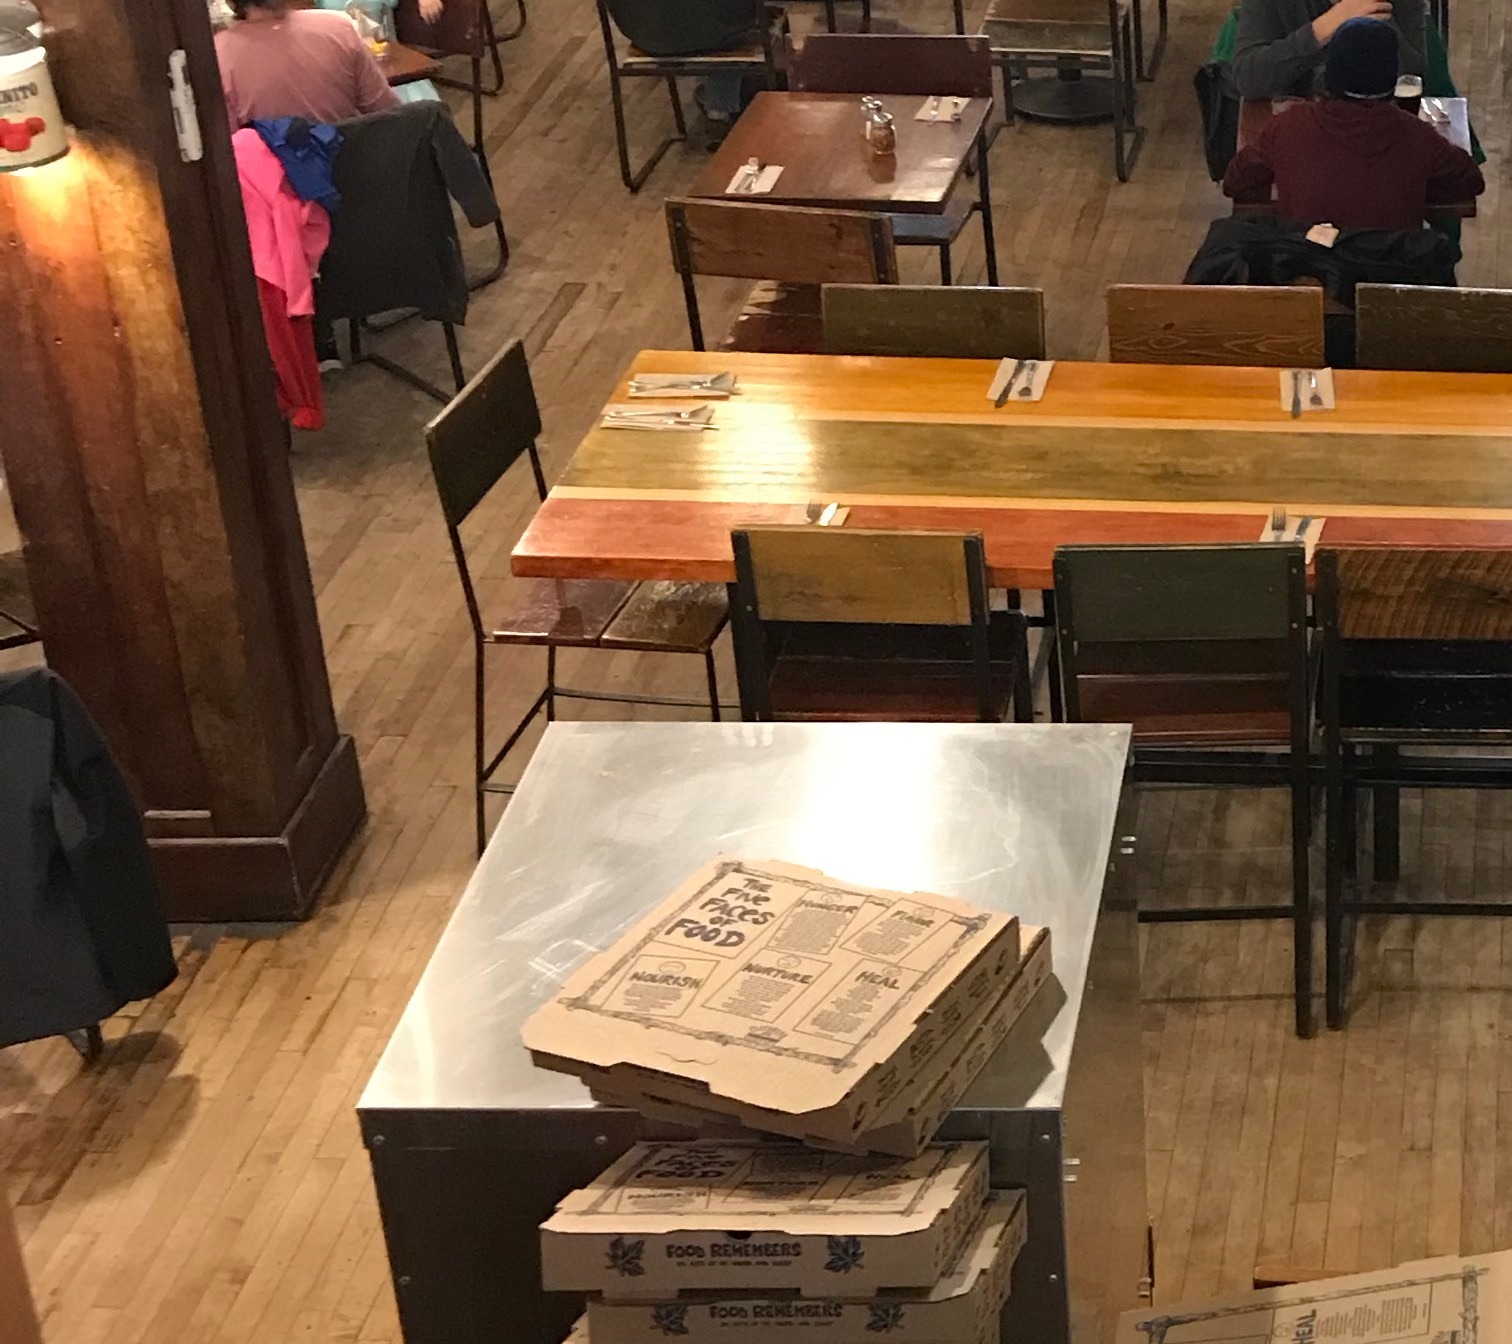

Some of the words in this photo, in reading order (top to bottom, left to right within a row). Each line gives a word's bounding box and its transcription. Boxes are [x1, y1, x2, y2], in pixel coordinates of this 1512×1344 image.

[743, 877, 773, 893] THE
[708, 915, 740, 928] OF
[664, 917, 745, 947] FOOD
[629, 971, 704, 991] NOURISH
[742, 962, 813, 985] NURTURE
[855, 970, 900, 990] HEAL
[666, 1244, 705, 1258] FOOD
[709, 1242, 802, 1258] REMEMBERS
[709, 1305, 748, 1319] FOOD
[752, 1303, 844, 1318] REMEMBERS
